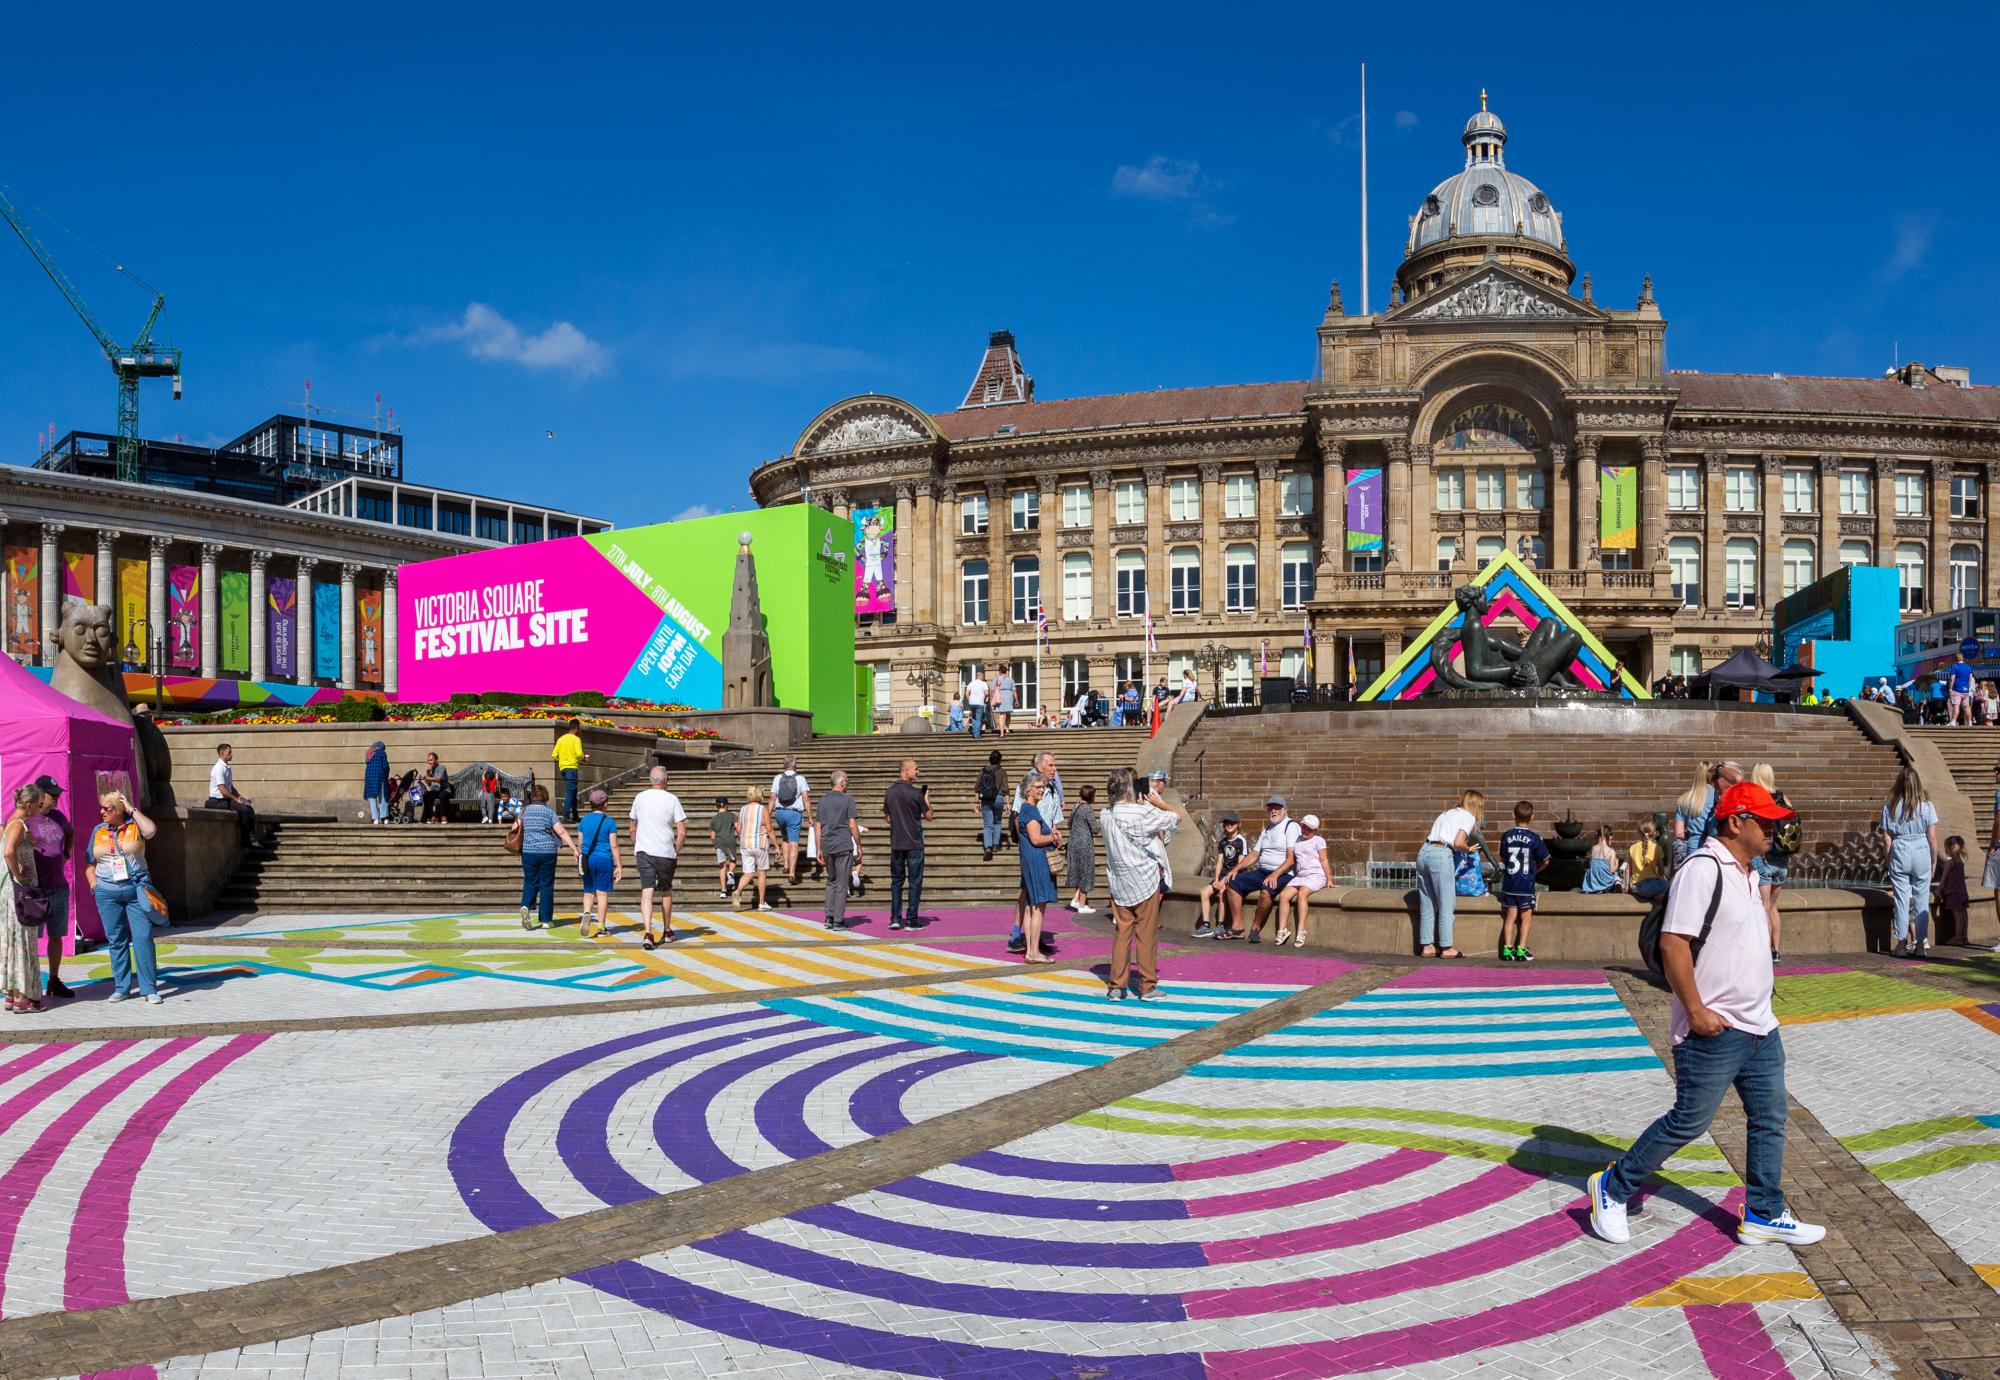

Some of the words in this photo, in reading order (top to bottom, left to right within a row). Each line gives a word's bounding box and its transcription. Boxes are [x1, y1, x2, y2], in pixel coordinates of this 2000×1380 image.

[415, 589, 479, 629] VICTORIA
[483, 579, 544, 619] SQUARE
[606, 543, 628, 567] 27TH
[623, 560, 653, 589] JULY
[651, 584, 670, 606] 8TH
[664, 597, 712, 643] AUGUST
[415, 617, 524, 661] FESTIVAL
[529, 608, 588, 648] SITE
[637, 647, 659, 676] OPEN
[652, 623, 676, 653] UNTIL
[657, 632, 687, 674] 10PM
[664, 661, 688, 690] EACH
[680, 642, 698, 667] DAY
[1507, 834, 1532, 844] BAILEY
[1507, 846, 1530, 875] 31
